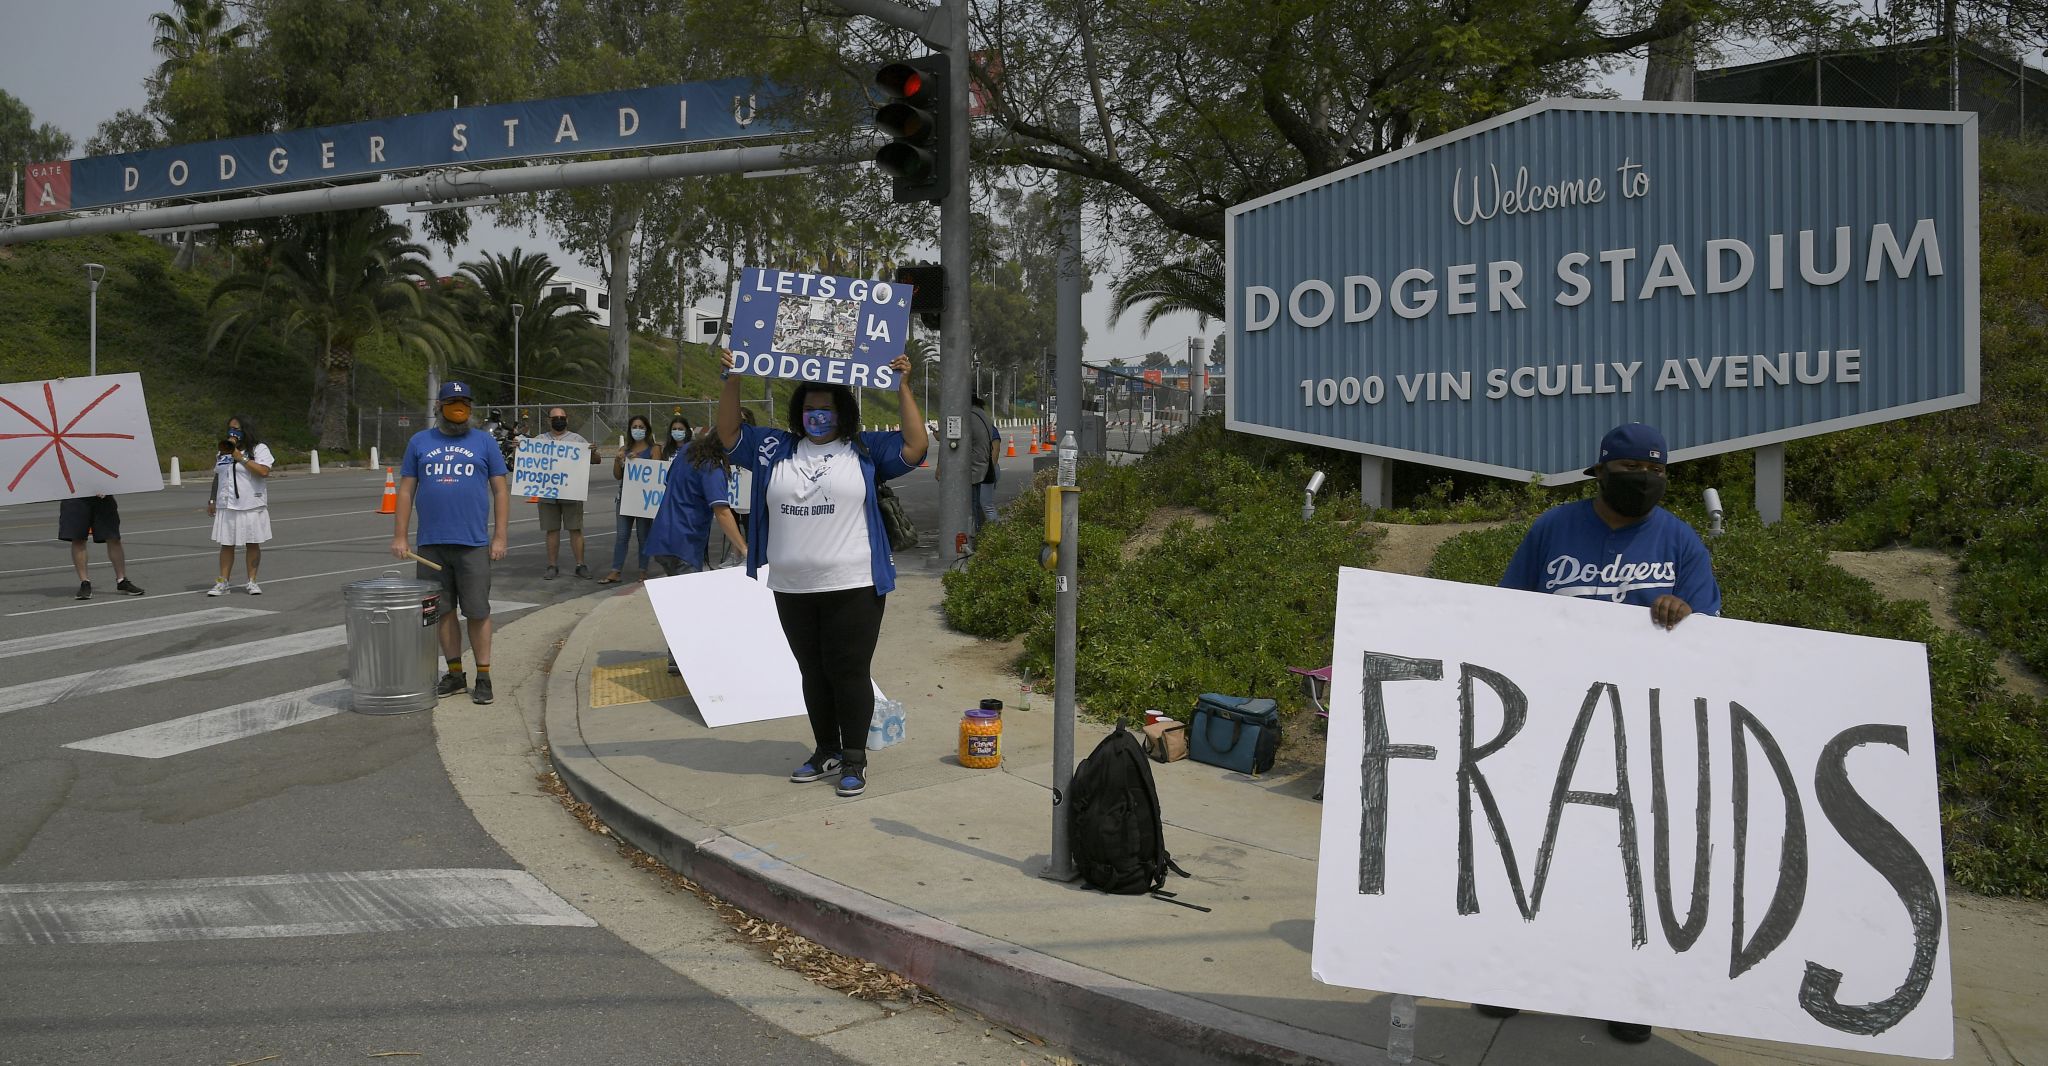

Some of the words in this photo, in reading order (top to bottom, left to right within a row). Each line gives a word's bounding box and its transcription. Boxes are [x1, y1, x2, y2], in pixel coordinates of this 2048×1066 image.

[32, 165, 62, 178] GATE
[123, 135, 386, 192] DODGER
[39, 182, 57, 207] A
[1453, 162, 1606, 226] Welcome
[1617, 156, 1651, 199] to
[756, 269, 837, 298] LETS
[849, 280, 893, 305] GO
[1244, 259, 1527, 333] DODGER
[1553, 217, 1944, 307] STADIUM
[865, 313, 891, 343] LA
[729, 350, 894, 389] DODGERS
[1300, 375, 1385, 408] 1000
[1396, 370, 1472, 403] VIN
[1486, 360, 1643, 399] SCULLY
[1654, 348, 1862, 392] AVENUE
[426, 447, 442, 458] THE
[445, 445, 474, 458] LEGEND
[517, 456, 558, 471] never
[518, 439, 580, 460] Cheaters
[425, 463, 475, 476] CHICO
[524, 485, 559, 499] 22-23
[811, 503, 835, 516] BOMB
[1546, 553, 1676, 603] Dodgers
[1358, 650, 1942, 1037] FRAUDS
